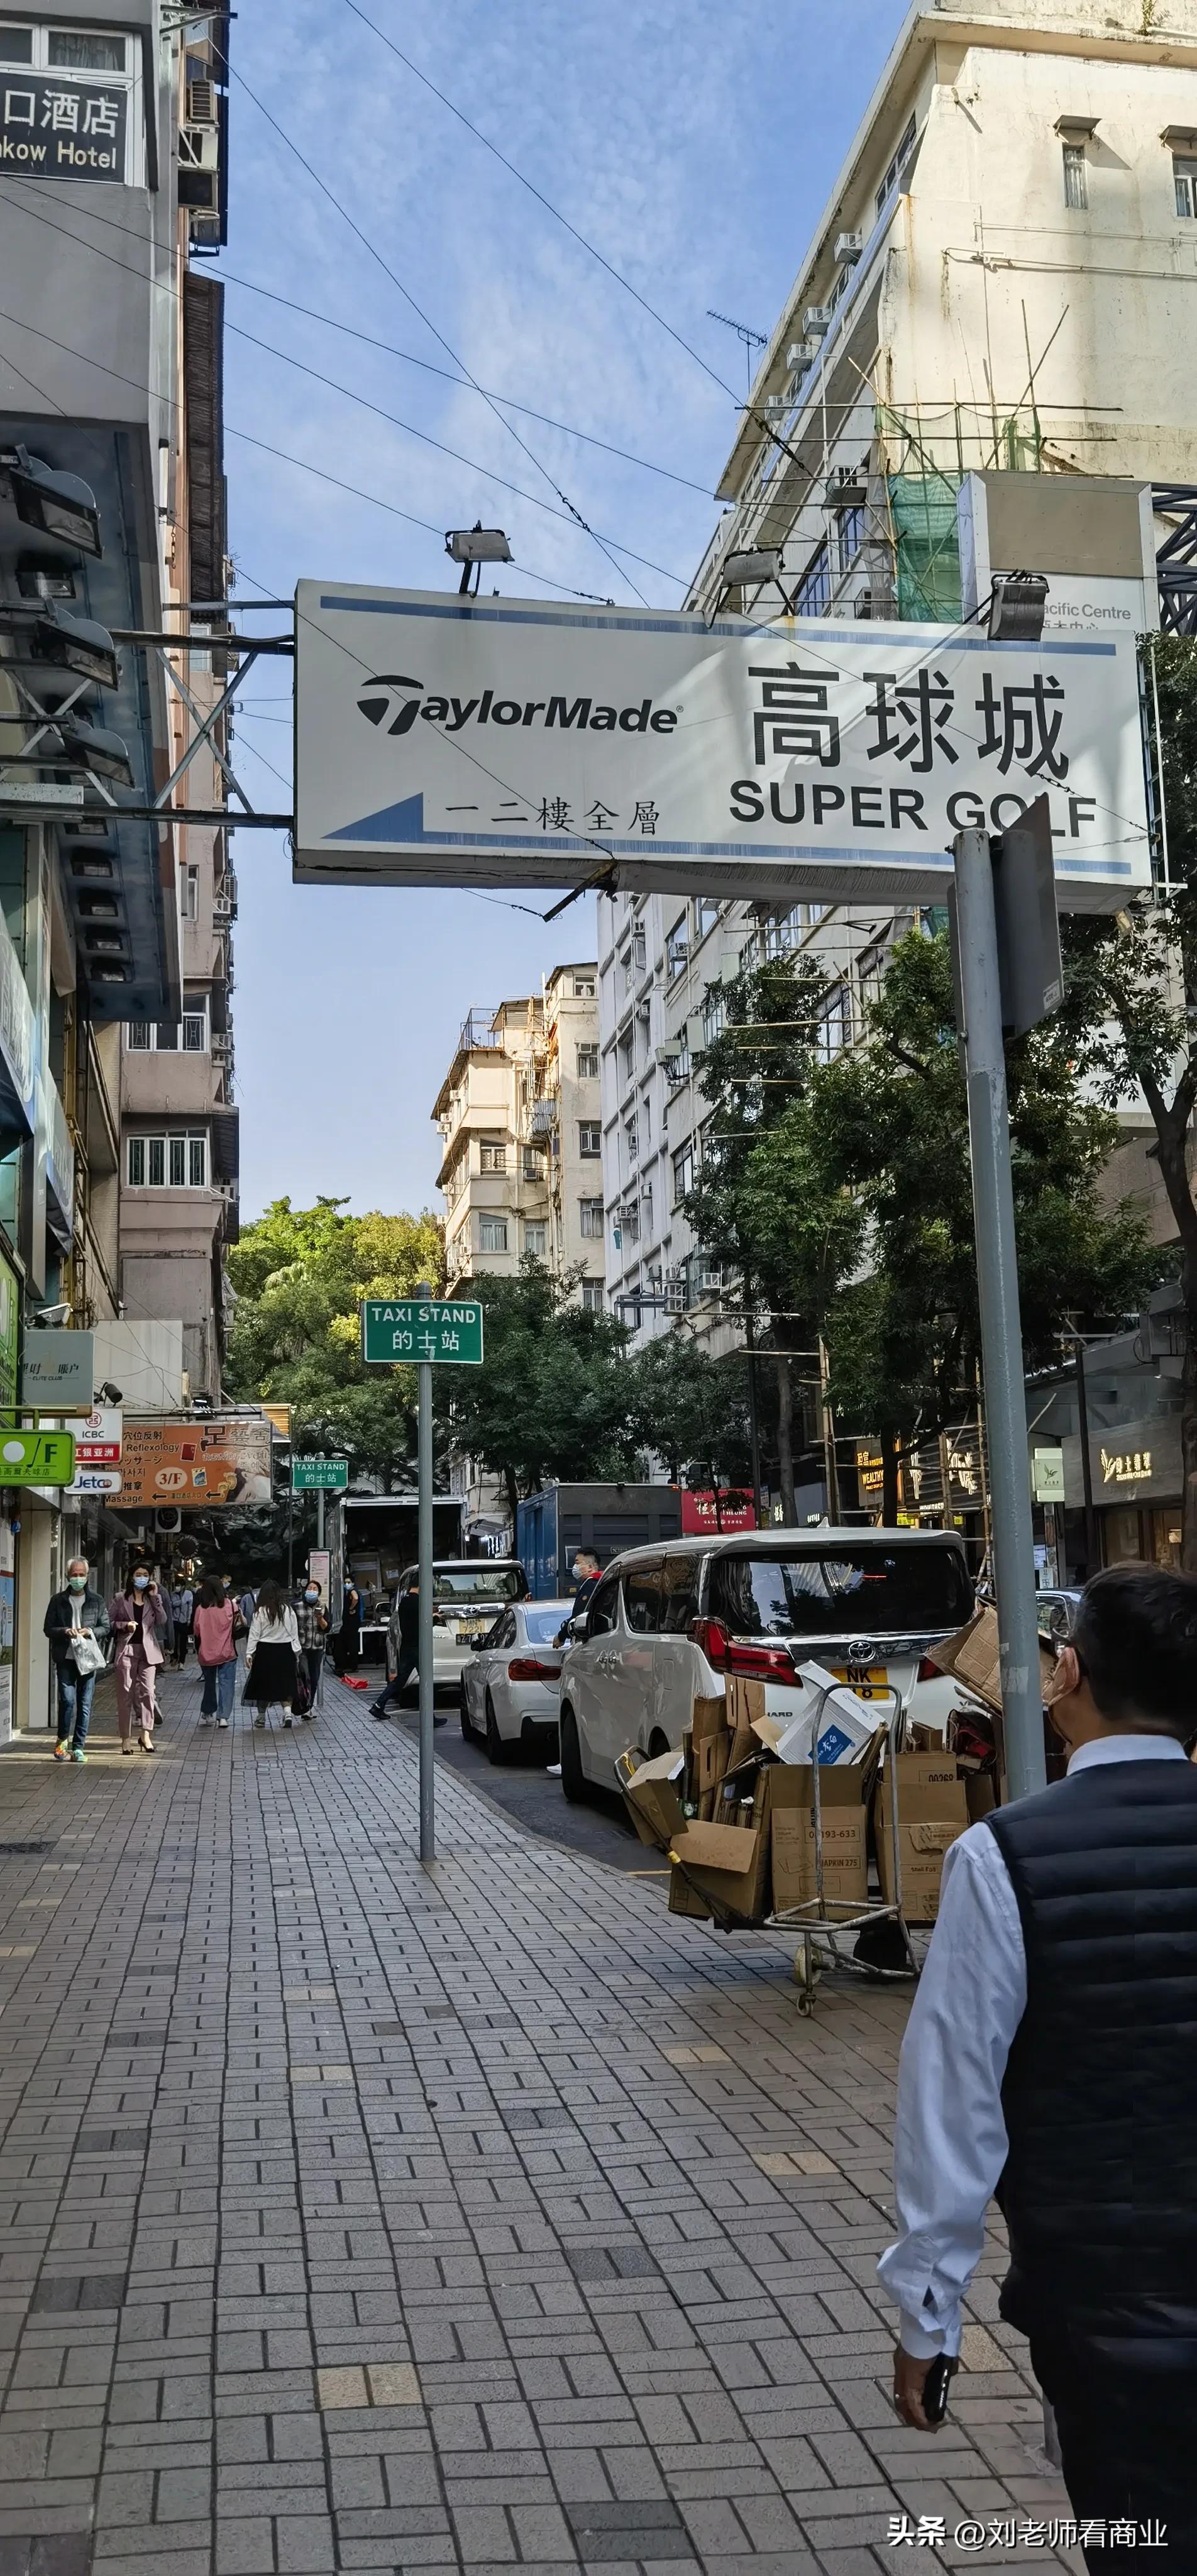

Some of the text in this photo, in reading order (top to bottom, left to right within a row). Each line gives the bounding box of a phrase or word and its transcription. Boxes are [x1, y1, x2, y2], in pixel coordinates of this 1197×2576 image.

[4, 89, 119, 138] 口酒店
[0, 135, 116, 169] kow Hotel
[1044, 602, 1132, 620] acific Centre
[356, 674, 679, 736] TaylorMade
[747, 662, 1069, 780] 高球城
[445, 796, 660, 836] 一二樓全層
[729, 780, 1096, 838] SUPER GOF
[372, 1307, 477, 1324] TAXI STAND
[392, 1330, 460, 1352] 的士站
[82, 1430, 105, 1438] ICBC
[126, 1443, 180, 1453] Reflexology
[107, 1468, 146, 1477] 마사지
[159, 1473, 182, 1485] 3/F
[305, 1473, 336, 1483] 的士站
[862, 1469, 884, 1485] WEALTHY
[74, 1476, 113, 1489] Jetco
[105, 1495, 143, 1504] Massage
[809, 1829, 856, 1840] 0193-633
[822, 1859, 844, 1867] APKIN
